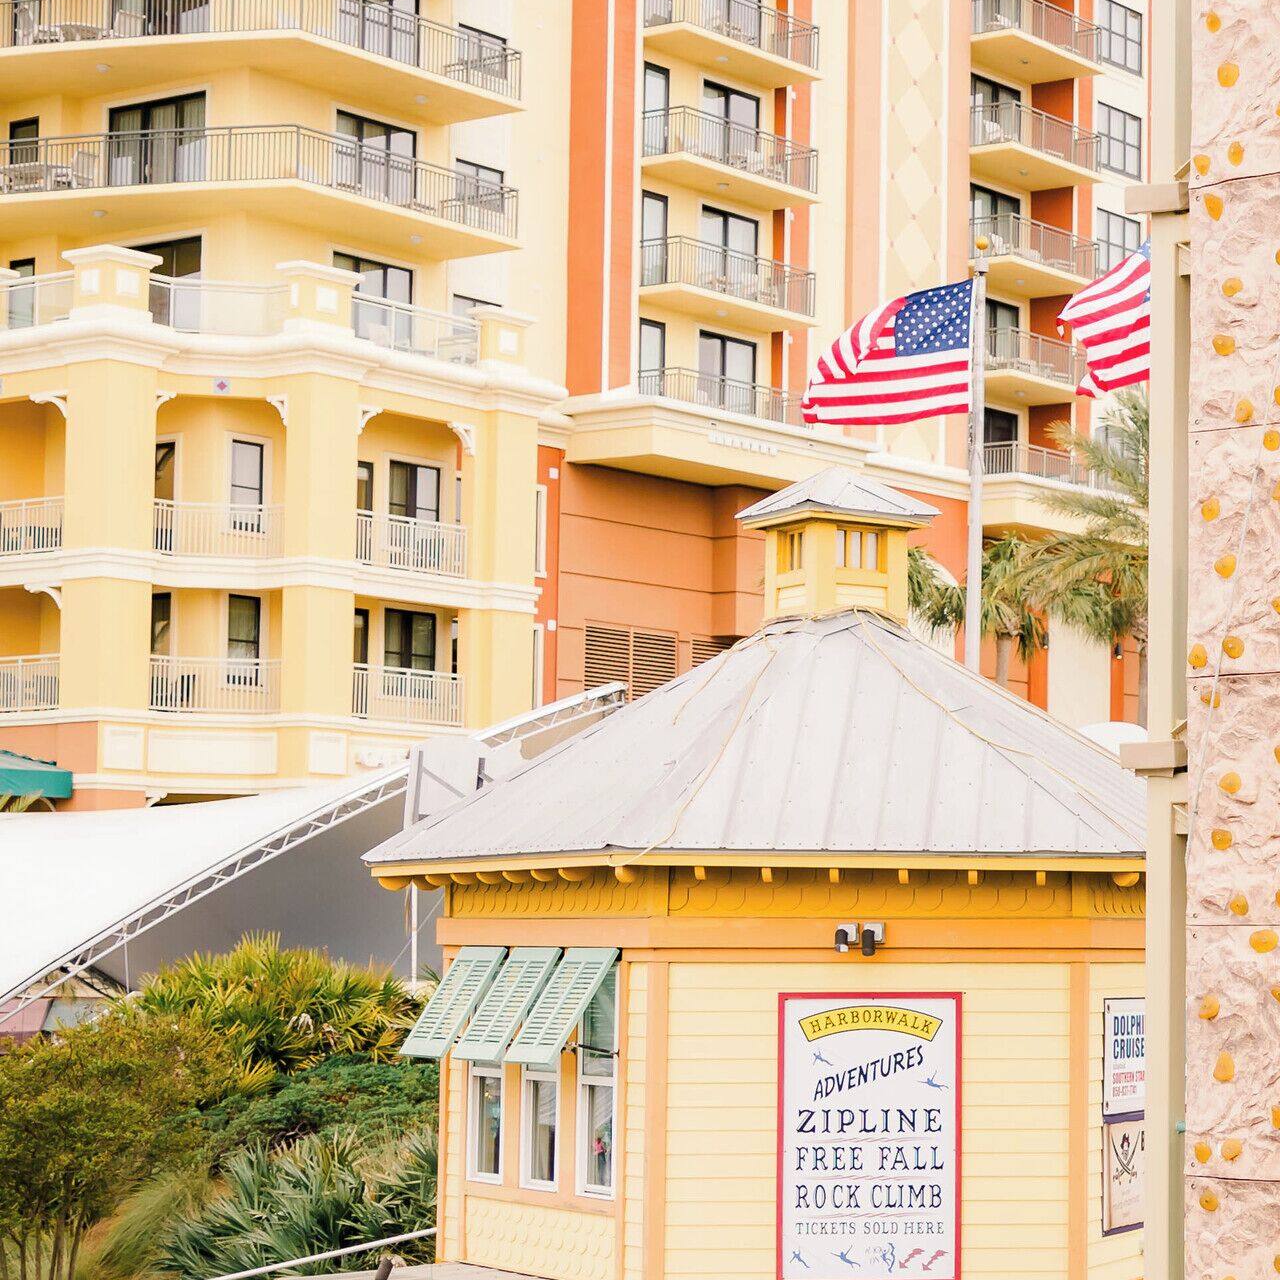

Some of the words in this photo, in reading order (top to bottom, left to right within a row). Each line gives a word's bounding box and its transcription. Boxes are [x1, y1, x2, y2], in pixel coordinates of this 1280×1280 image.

[808, 1009, 934, 1035] HARBORWALK
[813, 1045, 924, 1102] ADVENTURES
[796, 1108, 943, 1134] ZIPLINE
[795, 1146, 864, 1171] FREE
[878, 1146, 945, 1170] FALL
[795, 1184, 861, 1209] ROCK
[871, 1184, 942, 1208] CLIMB
[795, 1221, 857, 1235] TICKETS
[863, 1221, 899, 1235] SOLD
[904, 1221, 945, 1235] HERE
